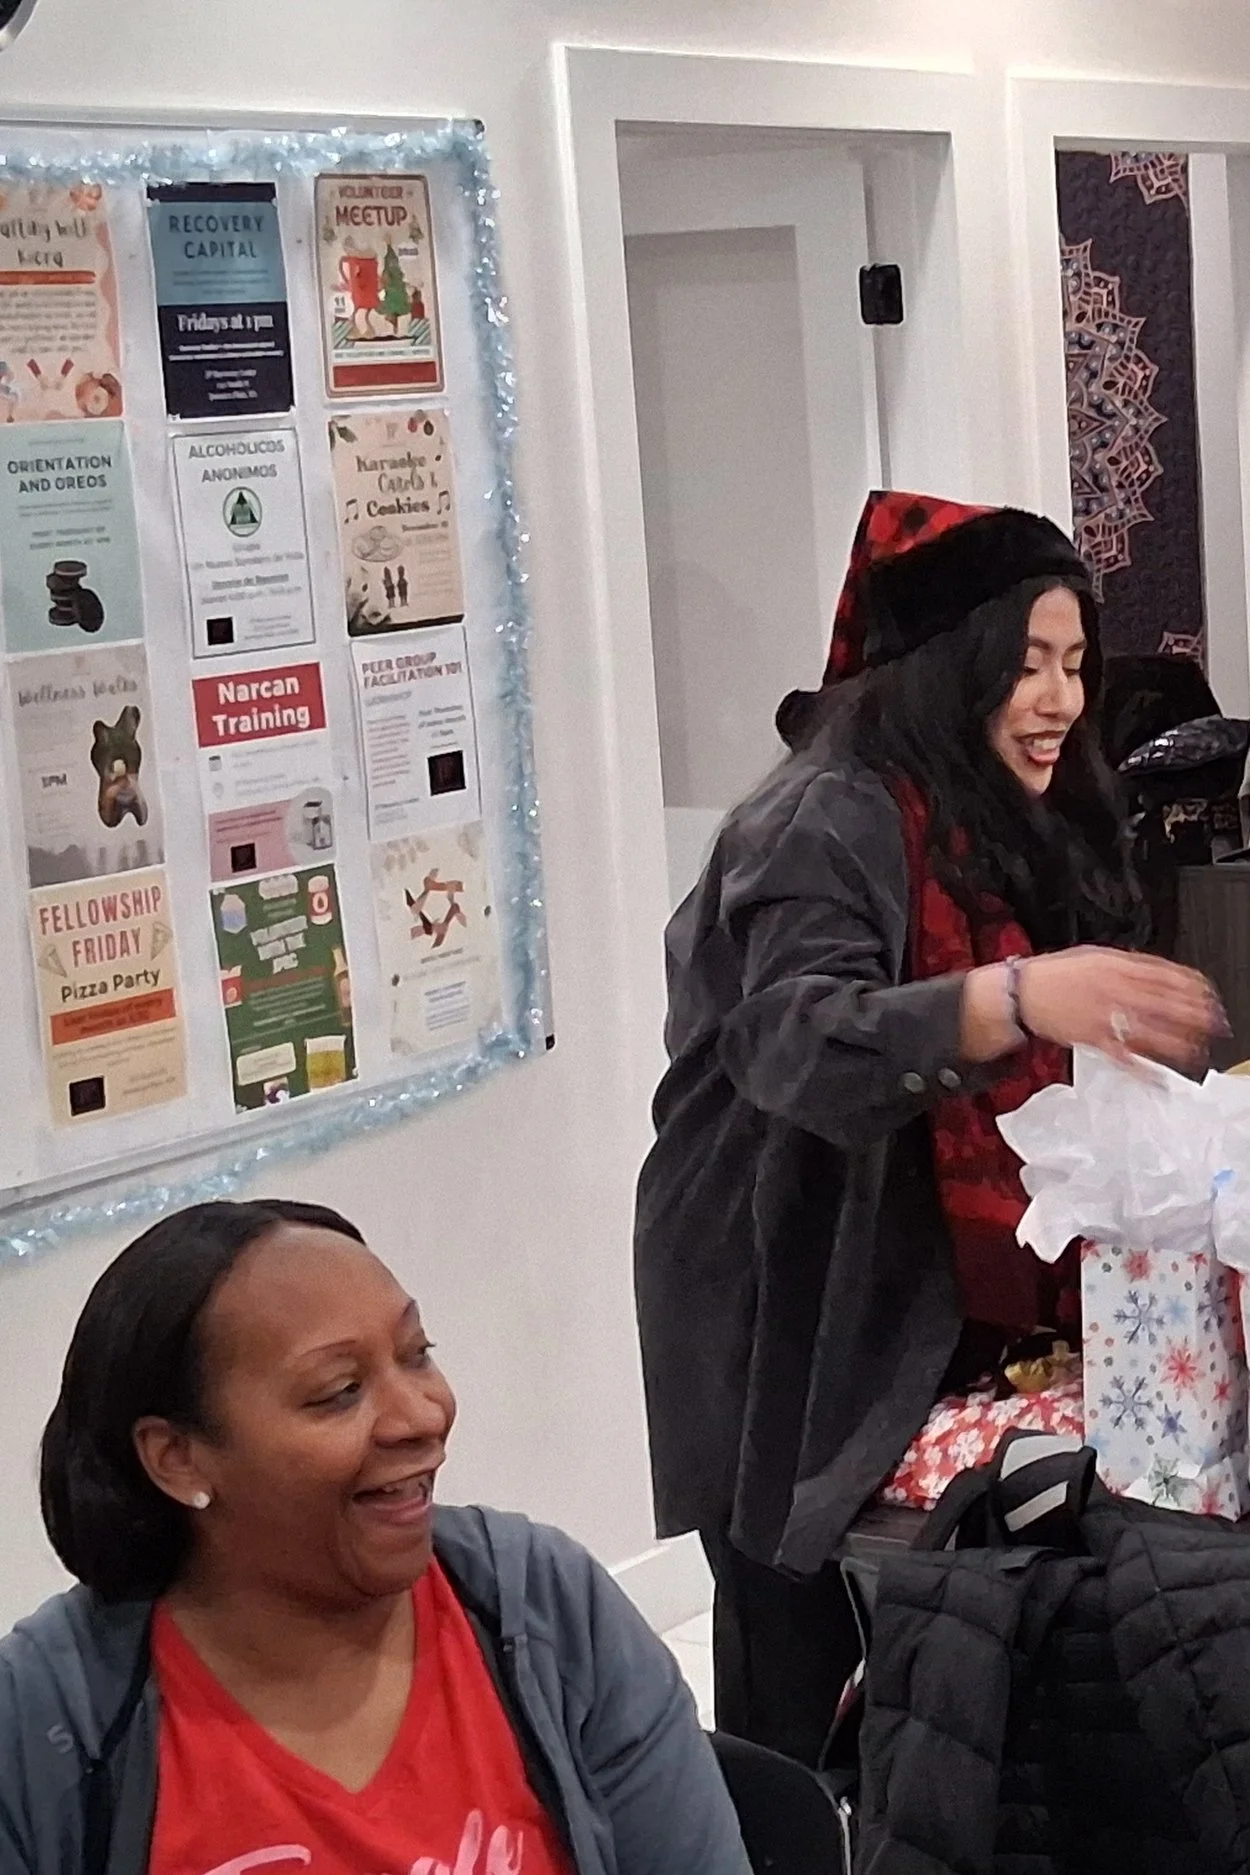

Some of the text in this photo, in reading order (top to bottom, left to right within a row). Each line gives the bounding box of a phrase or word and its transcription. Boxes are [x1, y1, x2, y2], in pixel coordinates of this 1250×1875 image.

[339, 186, 403, 199] VOLUNTEER
[169, 215, 265, 233] RECOVERY
[335, 205, 407, 226] MEETUP
[184, 241, 257, 259] CAPITAL
[177, 312, 228, 333] Fridays
[188, 439, 286, 459] ALCOHOLICOS
[7, 455, 112, 474] ORIENTATION
[356, 452, 427, 472] Karaoke
[19, 474, 107, 493] AND OREOS
[201, 464, 278, 483] ANONIMOS
[367, 497, 430, 518] Cookies
[362, 651, 437, 675] PEER GROUP
[364, 664, 443, 690] FACILITATION
[217, 676, 300, 705] Narcan
[212, 704, 311, 737] Training
[39, 885, 162, 935] FELLOWSHIP
[72, 927, 142, 968] FRIDAY
[61, 968, 161, 1003] Pizza Party
